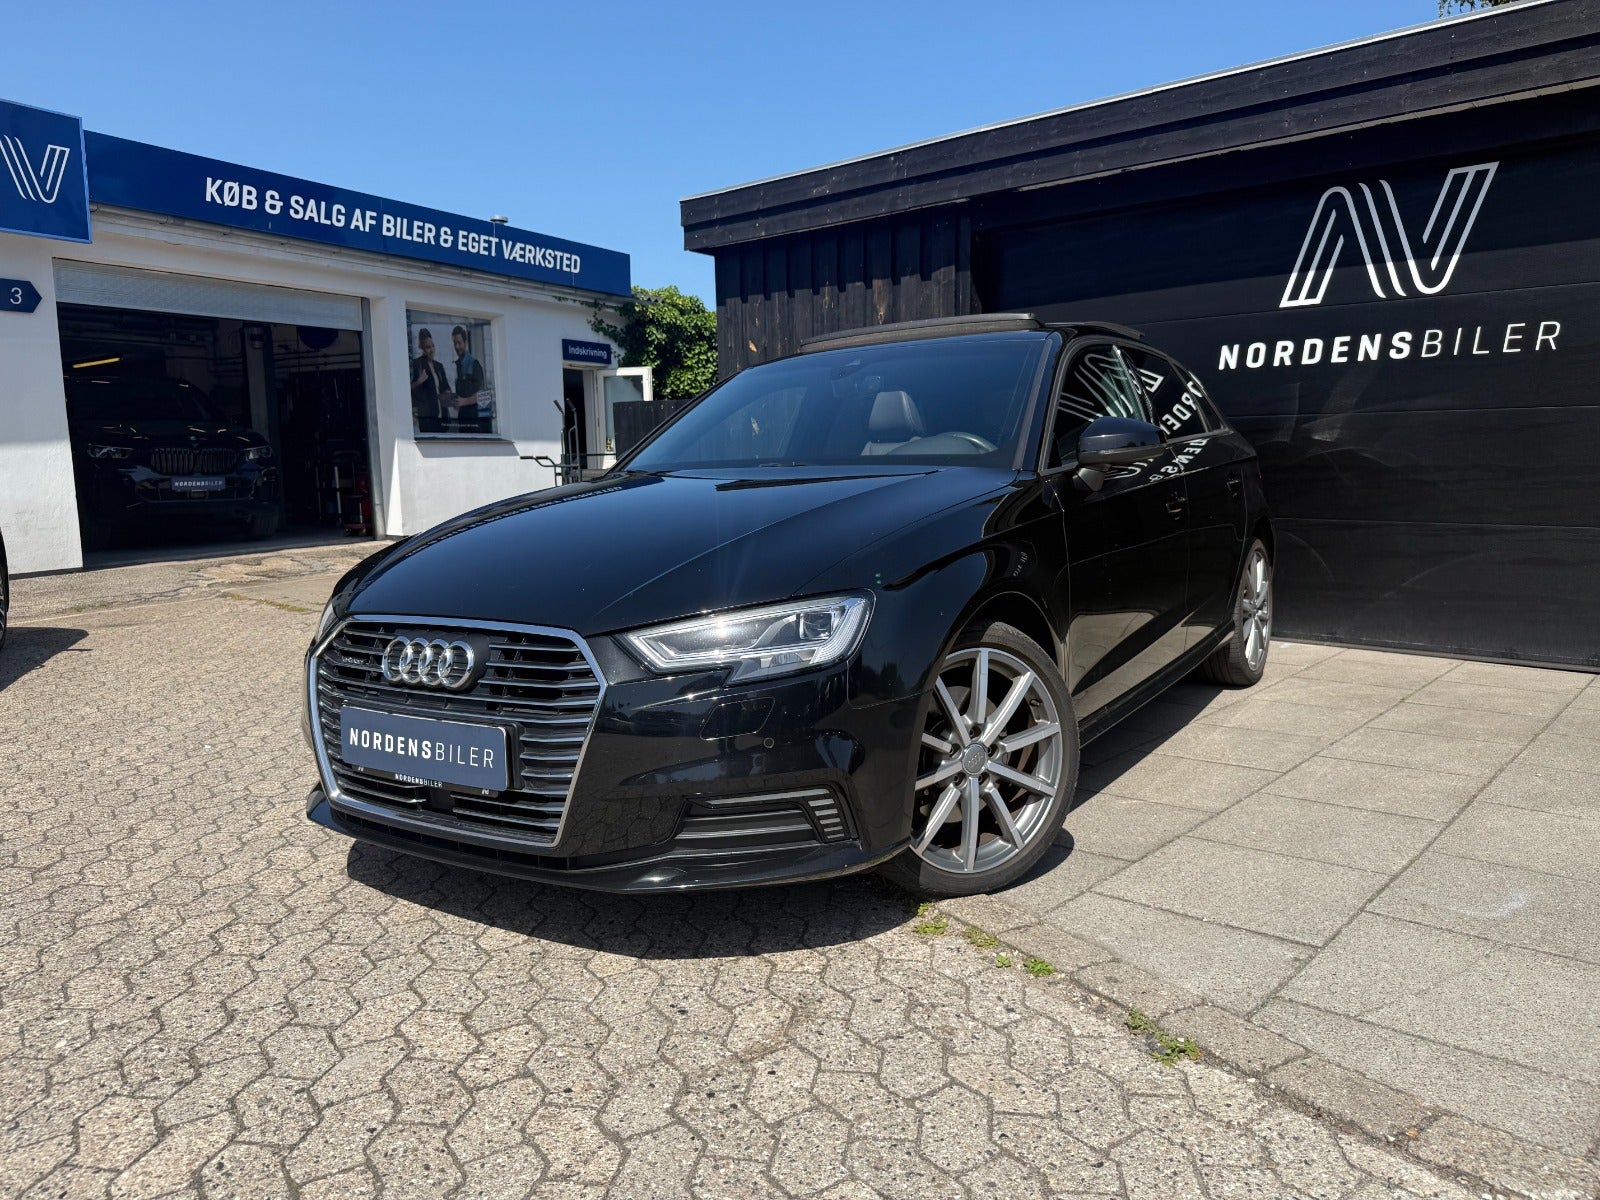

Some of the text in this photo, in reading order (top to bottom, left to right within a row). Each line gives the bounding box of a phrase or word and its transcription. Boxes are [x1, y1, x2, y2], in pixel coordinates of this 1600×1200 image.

[206, 177, 581, 274] KØB & SALG AF BILER & EGET VÆRKSTED
[10, 287, 23, 305] 3
[568, 344, 608, 360] Indskrivning
[1218, 320, 1562, 371] NORDENSBILER
[350, 727, 494, 769] NORDENSBILER
[395, 773, 443, 788] NORDENSBILER
